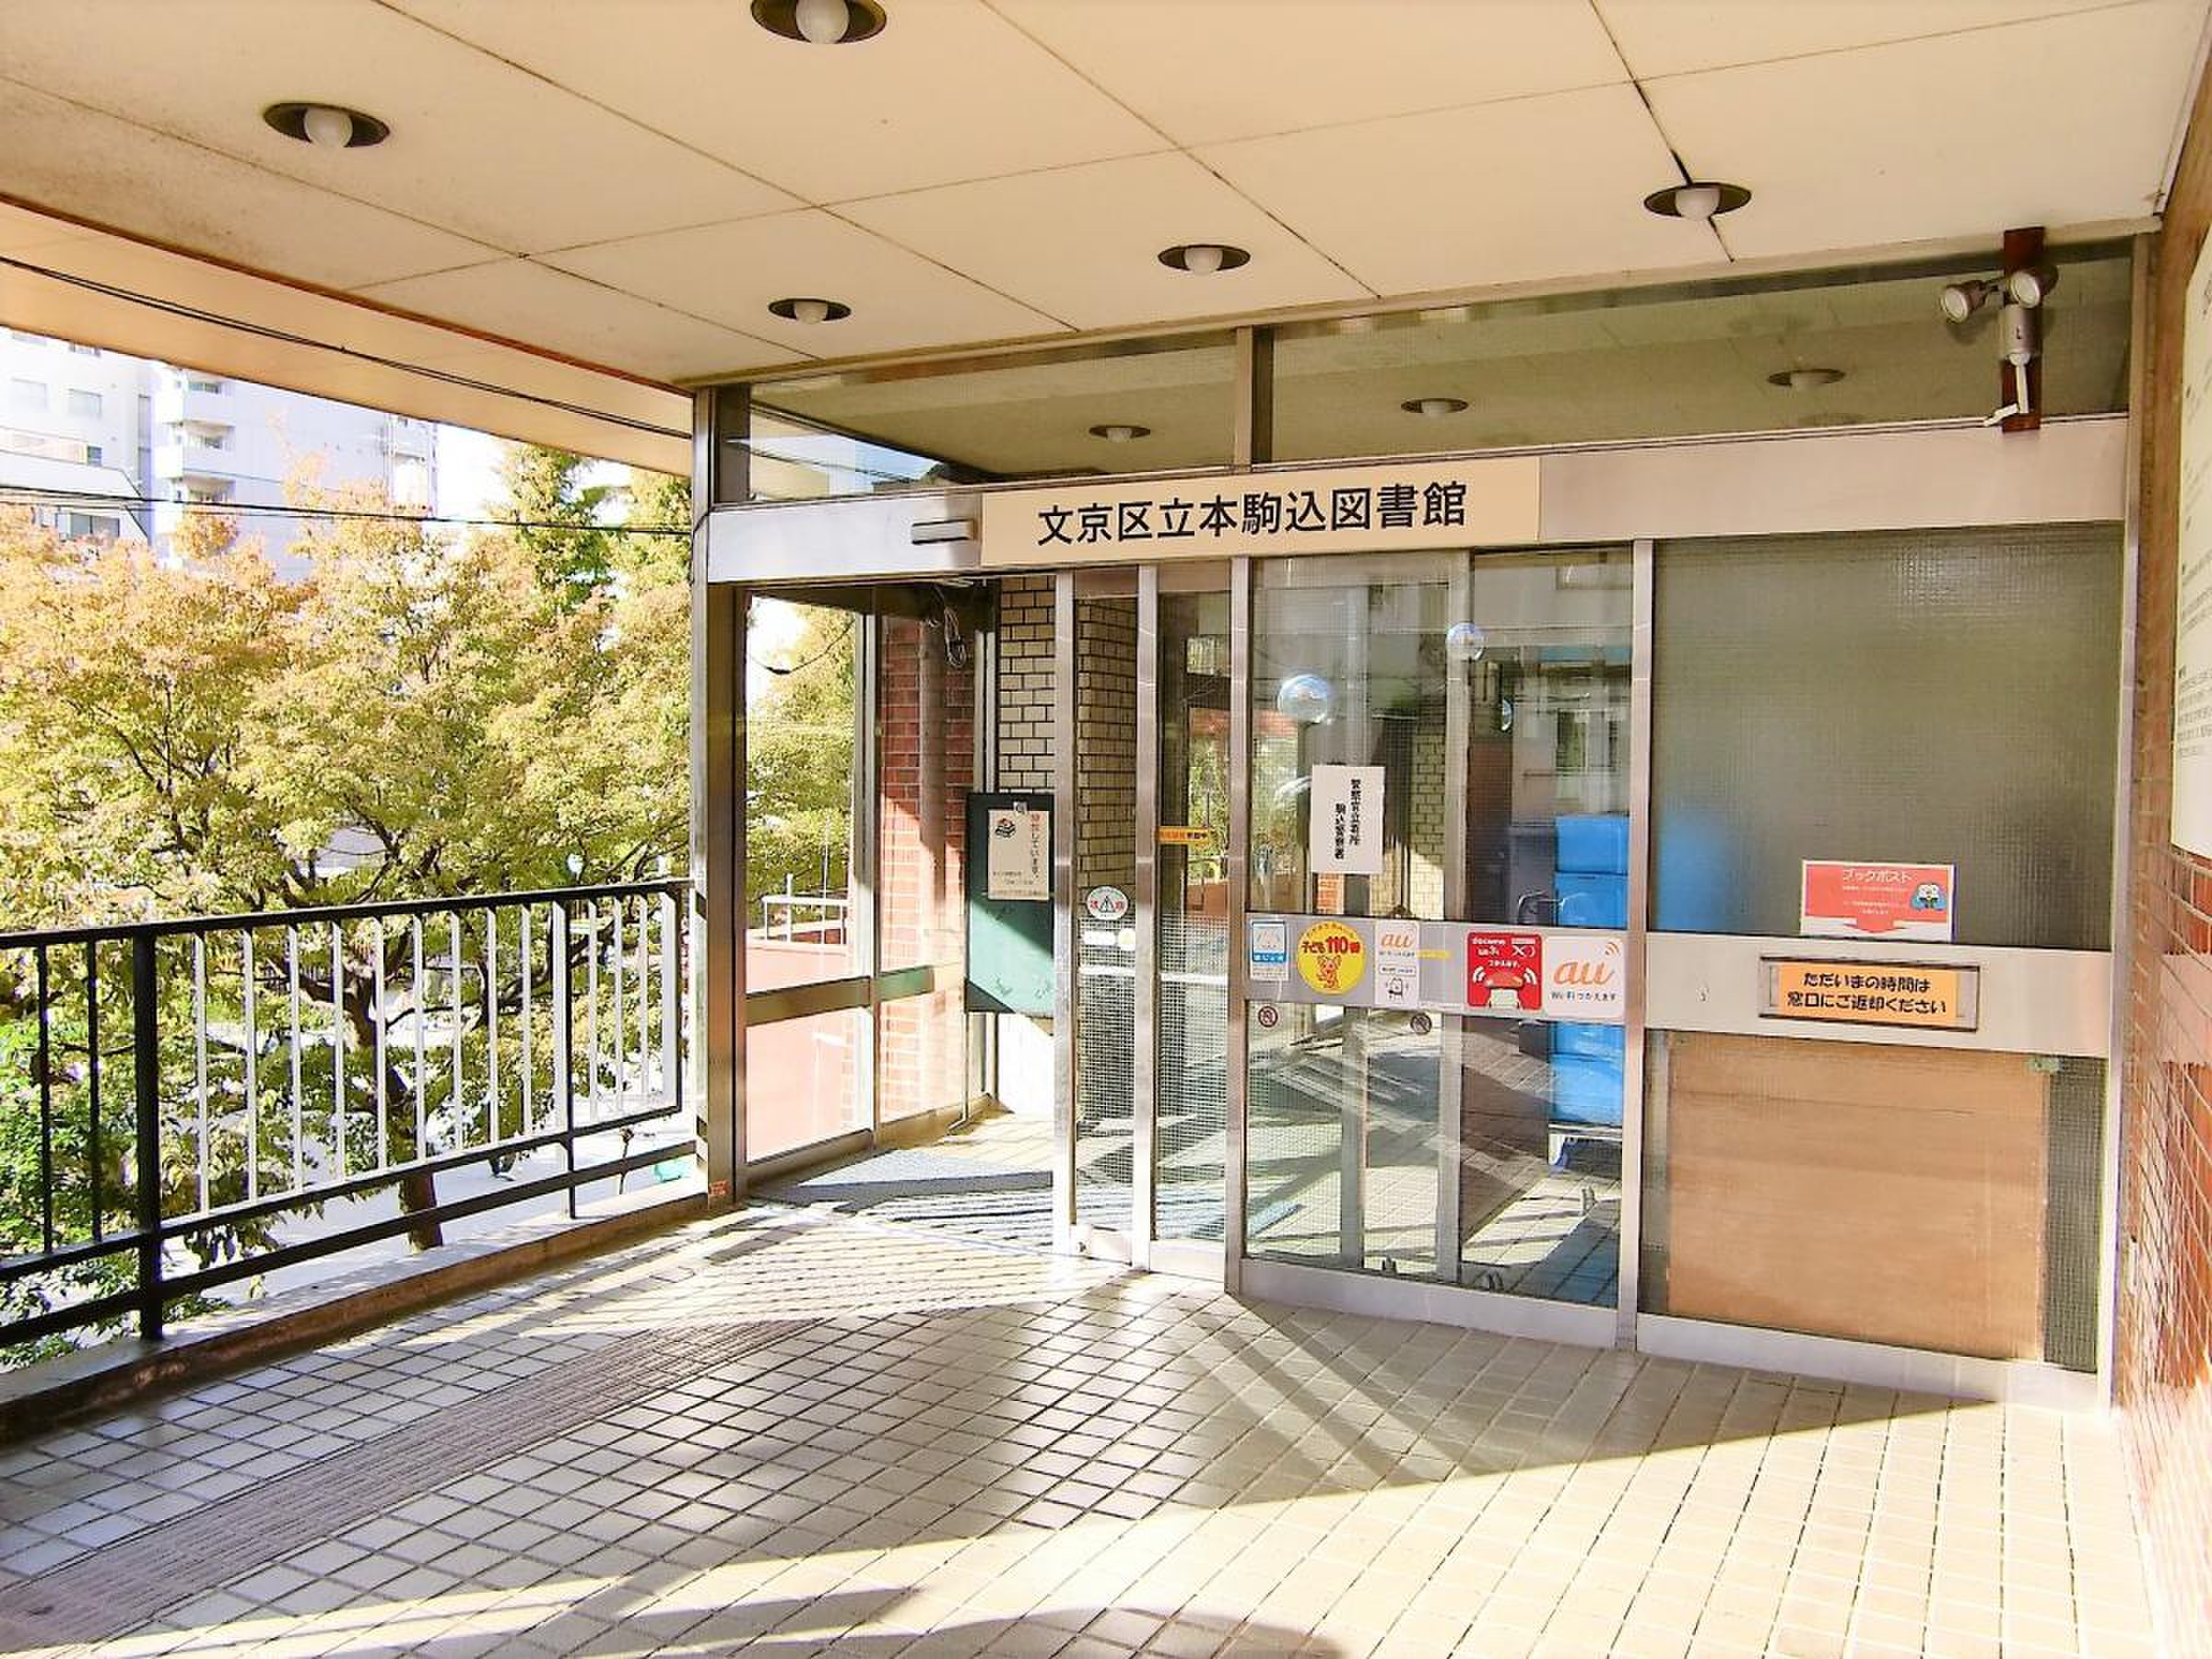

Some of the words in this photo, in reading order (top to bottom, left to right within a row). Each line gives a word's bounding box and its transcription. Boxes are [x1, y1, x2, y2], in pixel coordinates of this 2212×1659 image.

[1037, 480, 1467, 547] 文京区立本駒込図書館
[1842, 869, 1913, 884] ブックポスト
[1381, 933, 1413, 948] au
[1553, 961, 1616, 985] au
[1803, 971, 1931, 994] ただいまの時間は
[1786, 990, 1947, 1014] 窓口にご返却ください
